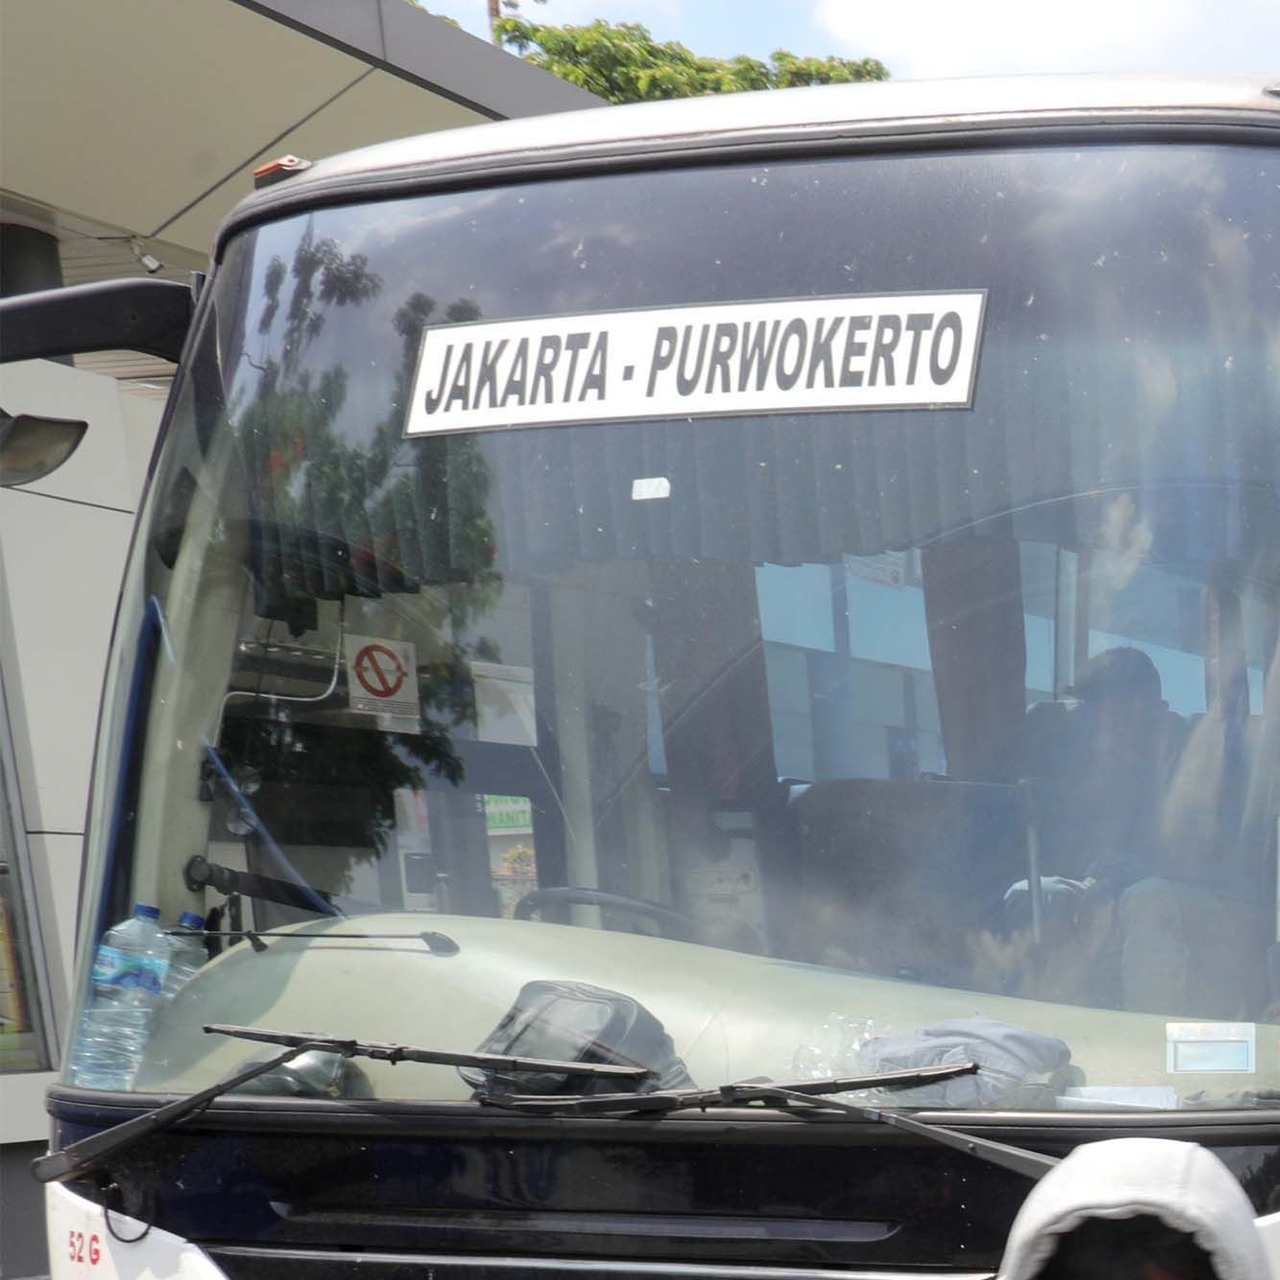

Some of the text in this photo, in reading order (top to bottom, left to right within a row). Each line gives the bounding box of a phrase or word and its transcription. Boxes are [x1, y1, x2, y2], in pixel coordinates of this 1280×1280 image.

[424, 331, 609, 415] JAKARTA
[645, 310, 963, 398] PURWOKERTO
[68, 1230, 85, 1263] 52
